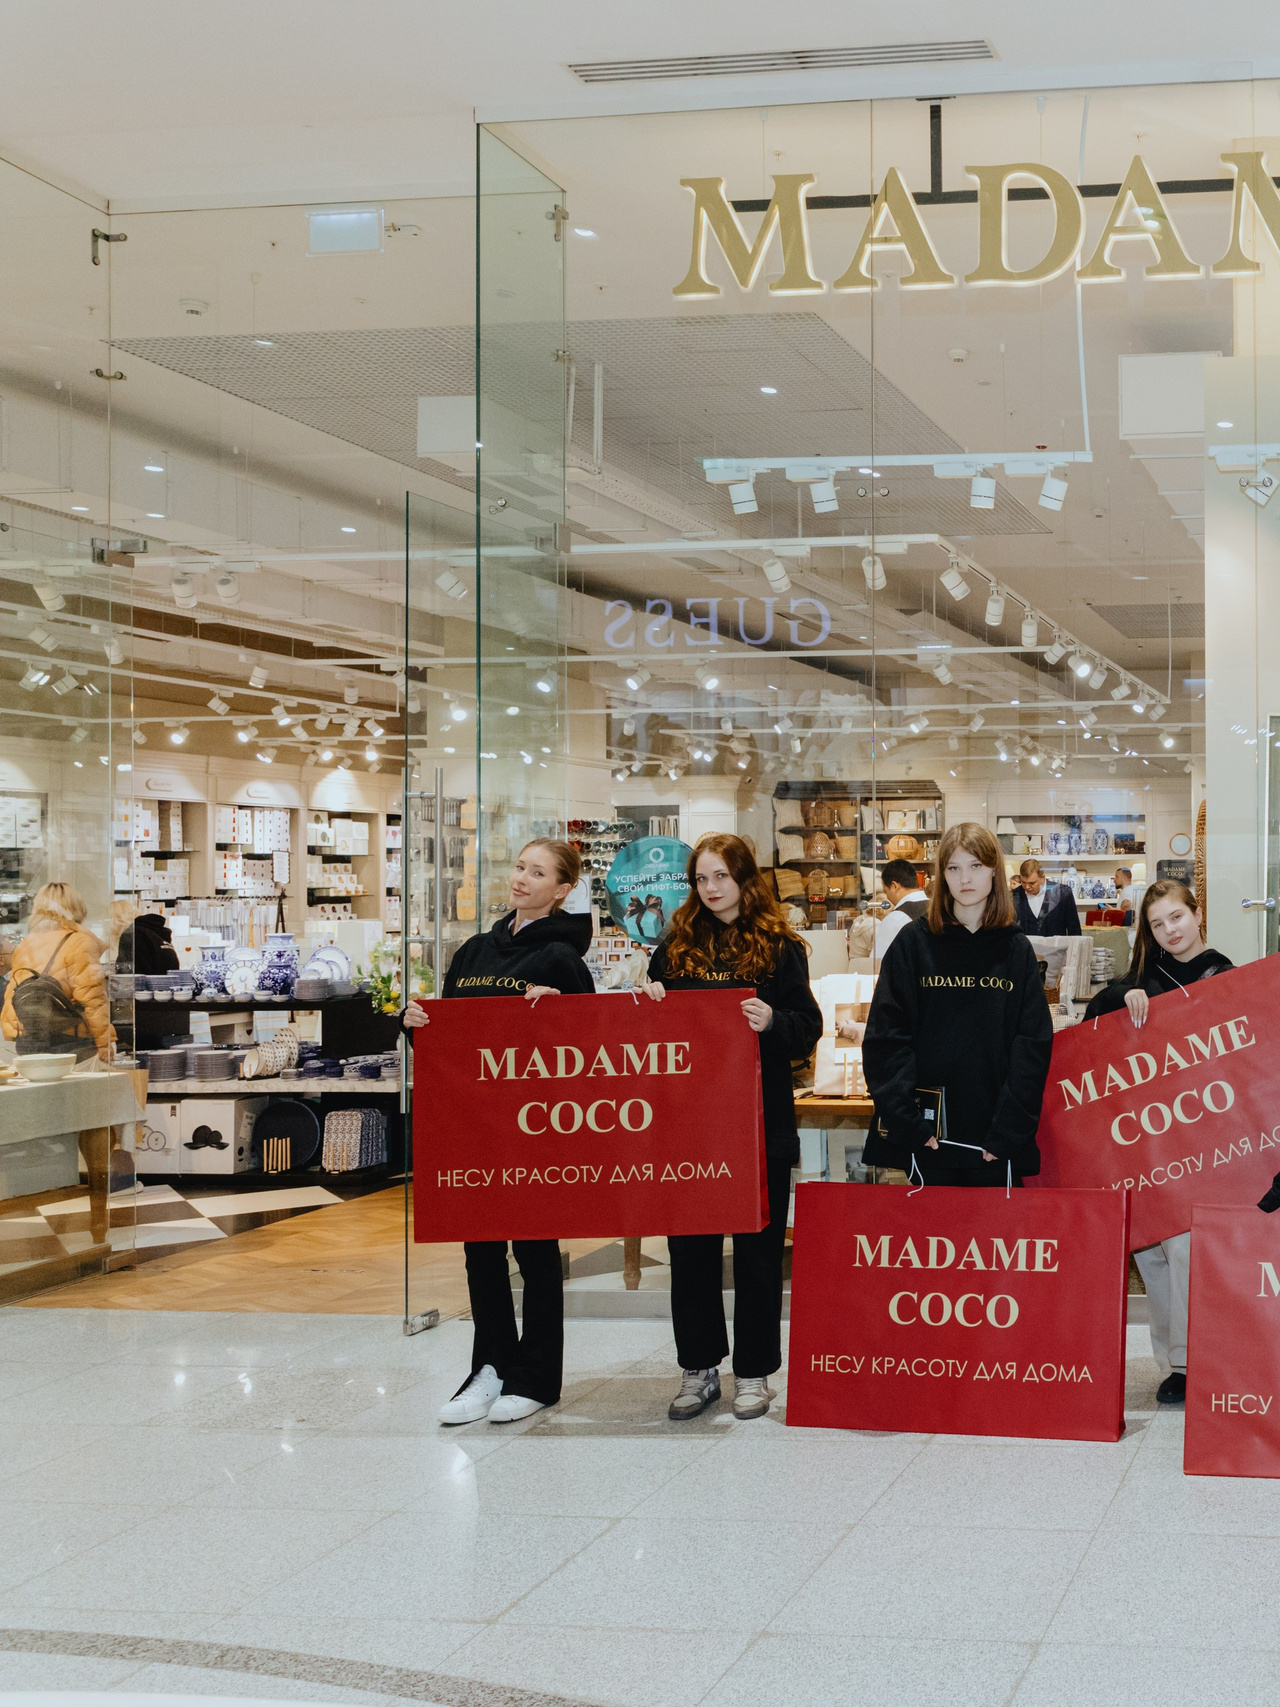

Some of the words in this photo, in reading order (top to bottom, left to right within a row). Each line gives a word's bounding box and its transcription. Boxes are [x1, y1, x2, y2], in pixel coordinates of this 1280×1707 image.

[615, 873, 657, 883] УСПЕЙТЕ
[659, 872, 689, 881] ЗАБРА
[617, 883, 644, 893] СВОЙ
[646, 882, 692, 891] ГИФТ-БОК
[979, 976, 1014, 992] COCO
[476, 1041, 692, 1081] MADAME
[1057, 1016, 1256, 1111] MADAME
[517, 1098, 653, 1135] COCO
[1111, 1080, 1235, 1146] COCO
[1212, 1136, 1253, 1168] ДЛЯ
[437, 1168, 495, 1188] НЕСУ
[502, 1165, 603, 1186] КРАСОТУ
[609, 1163, 654, 1185] ДЛЯ
[660, 1161, 732, 1183] ДОМА
[852, 1234, 1059, 1273] MADAME
[888, 1291, 1020, 1329] COCO
[811, 1354, 866, 1374] НЕСУ
[871, 1356, 968, 1378] КРАСОТУ
[973, 1361, 1017, 1382] ДЛЯ
[1022, 1362, 1093, 1384] ДОМА
[1211, 1393, 1273, 1415] НЕСУ
